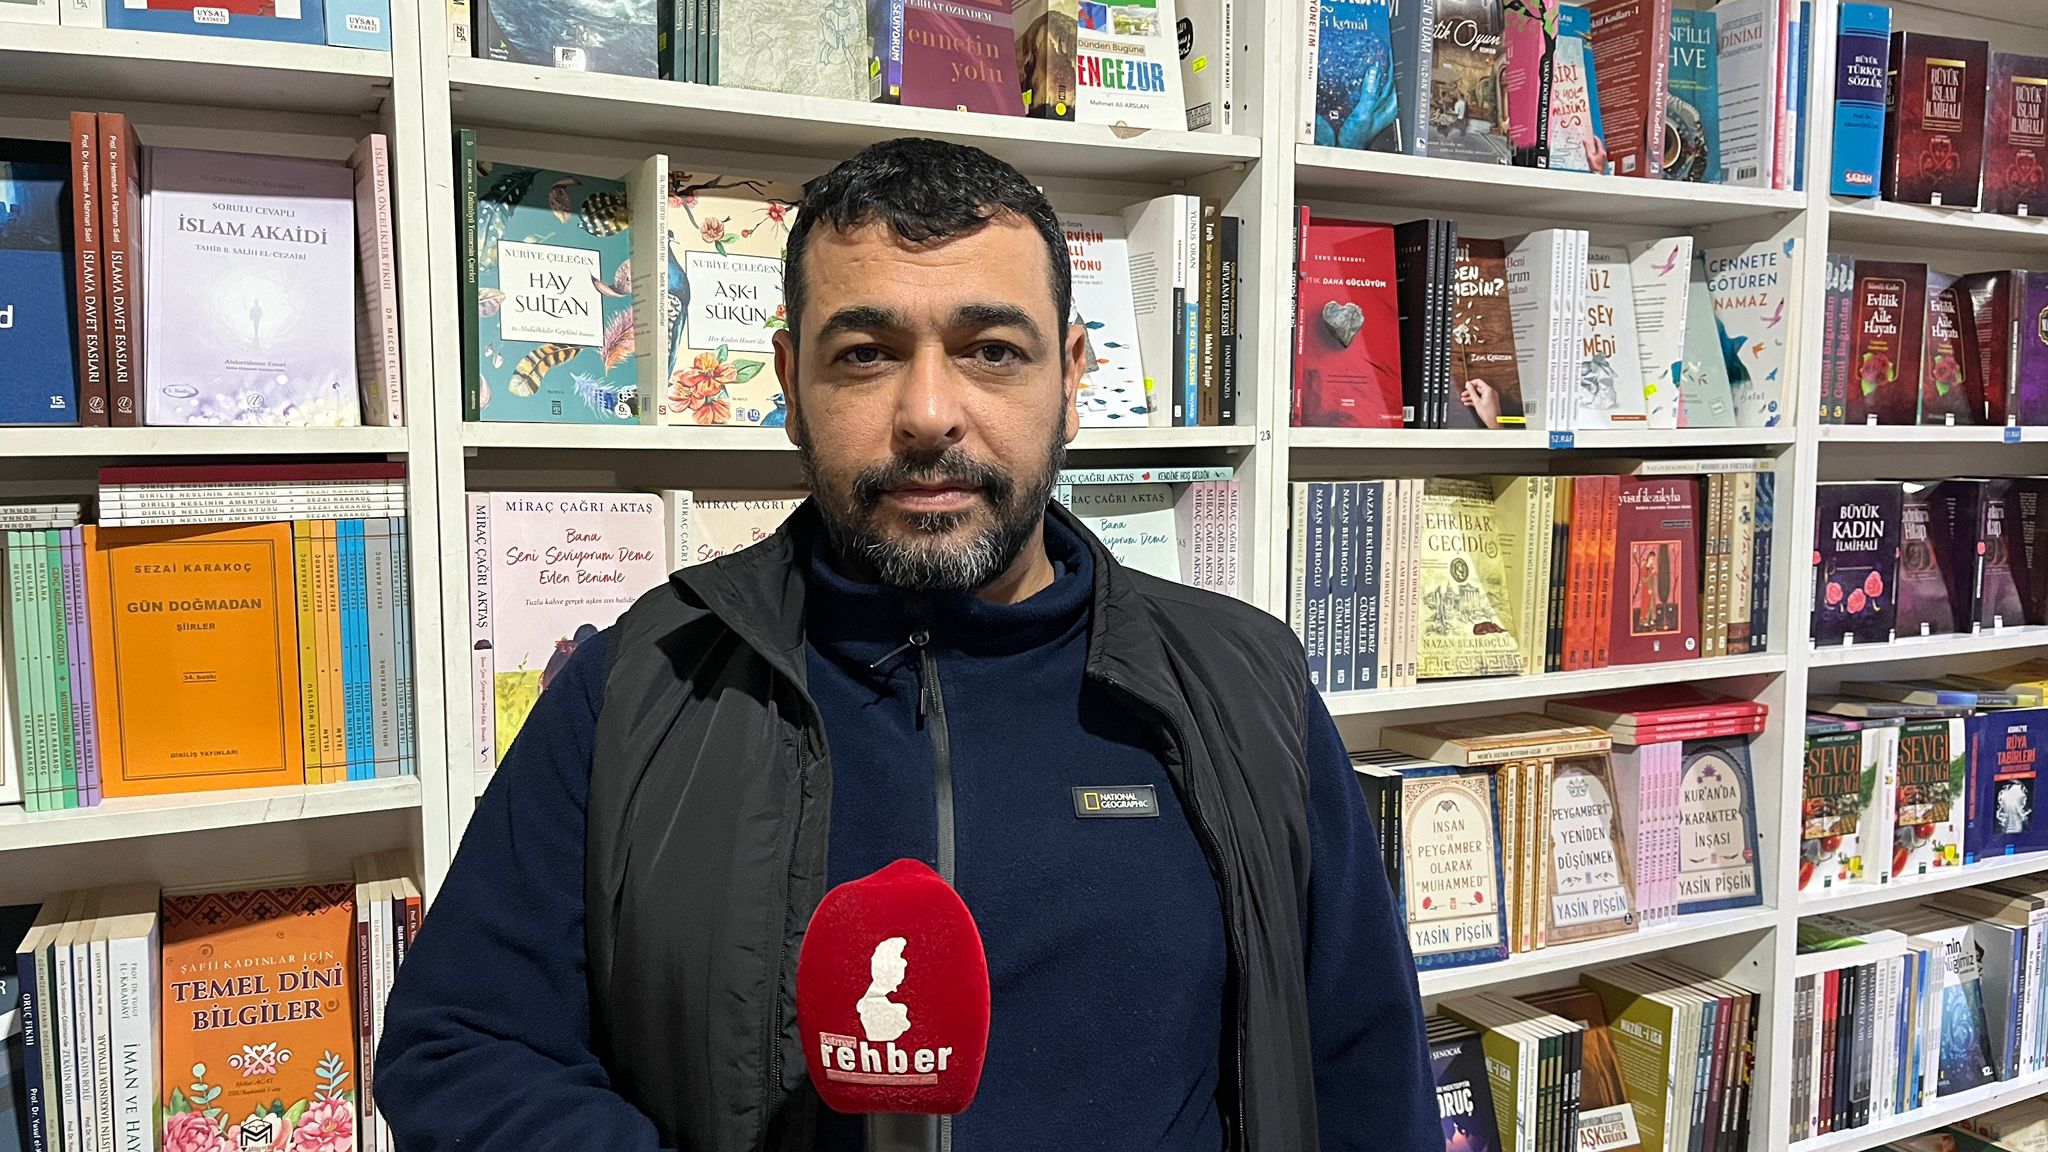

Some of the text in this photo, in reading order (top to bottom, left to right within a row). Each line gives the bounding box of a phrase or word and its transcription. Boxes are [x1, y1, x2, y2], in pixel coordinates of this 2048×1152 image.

[197, 9, 225, 19] UYSAL
[349, 17, 376, 27] UYSAL
[1454, 19, 1501, 52] Oyun
[1078, 39, 1145, 54] Dünden Bugüne
[1856, 56, 1878, 66] BÜYÜK
[951, 60, 1003, 83] yolu
[1076, 55, 1165, 92] ENGEZUR
[1847, 65, 1883, 78] TÜRKÇE
[1932, 68, 1959, 87] BÜYÜK
[1848, 76, 1883, 88] SÖZLÜK
[1932, 86, 1957, 103] İSLAM
[1925, 101, 1961, 120] İLMİHALİ
[2017, 102, 2040, 119] İSLAM
[2011, 117, 2043, 135] İLMİHALİ
[1845, 173, 1872, 184] SABAH
[212, 202, 295, 218] SORULU CEVAPLI
[178, 213, 328, 245] İSLAM AKAİDİ
[1189, 211, 1197, 269] YUNUS ORAN
[505, 248, 594, 266] NURİYE ÇELEĞEN
[1507, 256, 1526, 268] Beni
[1709, 252, 1778, 273] CENNETE
[693, 259, 776, 274] NURİYE ÇELEĞEN
[530, 271, 573, 295] HAY
[1222, 261, 1231, 299] MEVLANA
[1707, 272, 1778, 292] GÖTÜREN
[715, 281, 757, 301] AŞK-I
[515, 294, 589, 319] SULTAN
[1714, 293, 1768, 311] NAMAZ
[1866, 294, 1899, 308] Evlilik
[1931, 300, 1955, 314] Evlilik
[84, 297, 97, 332] DAVET
[113, 297, 126, 331] DAVET
[705, 302, 767, 326] SÜKÛN
[1221, 300, 1230, 336] FELSEFESİ
[1588, 304, 1613, 331] ŞEY
[1871, 310, 1892, 324] Aile
[1937, 316, 1953, 329] Aile
[1864, 321, 1897, 337] Hayatı
[1932, 326, 1958, 340] Hayatı
[87, 333, 99, 383] ESASLARI
[115, 333, 129, 382] ESASLARI
[1259, 431, 1272, 441] 28
[1551, 434, 1574, 444] 52.RAF
[1058, 470, 1210, 484] RAÇ ÇAĞRI AKTAŞ KENDİNE HOŞ GELDİN
[506, 499, 653, 515] MİRAÇ ÇAĞRI AKTAŞ
[695, 499, 784, 511] MİRAÇ ÇAĞRI
[1072, 493, 1165, 505] RAÇ ÇAĞRI AKTAŞ
[1840, 503, 1879, 519] BÜYÜK
[680, 498, 689, 562] MİRAÇ ÇAĞRI
[1101, 519, 1126, 531] Bana
[1425, 512, 1492, 532] EHRİBAR
[1832, 520, 1885, 540] KADIN
[566, 528, 602, 543] Bana
[1140, 532, 1168, 546] Deme
[1428, 533, 1484, 555] GEÇİDİ
[1836, 537, 1878, 552] İLMİHALİ
[506, 546, 654, 568] Seni Seviyorum Deme
[1313, 526, 1322, 587] BEKİROĞLU
[1340, 526, 1349, 586] BEKİROĞLU
[134, 561, 252, 575] SEZAİ KARAKOÇ
[474, 505, 489, 628] MİRAÇ ÇAĞRI AKTAŞ
[539, 569, 626, 584] Evlen Benimle
[127, 597, 262, 613] GÜN DOĞMADAN
[177, 621, 216, 633] ŞİİRLER
[1308, 599, 1317, 657] CÜMLELER
[1334, 598, 1343, 656] CÜMLELER
[1317, 625, 1325, 657] YERSİZ
[1424, 634, 1510, 649] NAZAN BEKİROĞLU
[1900, 734, 1949, 764] SEVGİ
[2006, 734, 2027, 749] RÜYA
[170, 748, 239, 759] DİRİLİŞ YAYINLARI
[1807, 744, 1862, 777] SEVGİ
[1997, 748, 2036, 765] TABİRLERİ
[1901, 762, 1949, 786] MUTFAĞI
[1684, 785, 1737, 802] KUR'AN'DA
[1807, 773, 1860, 797] MUTFAĞI
[1100, 793, 1137, 801] NATIONAL
[1101, 800, 1149, 809] GEOGRAPHIC
[1432, 818, 1465, 834] İNSAN
[1685, 809, 1738, 826] KARAKTER
[1561, 826, 1605, 844] YENİDEN
[1695, 832, 1731, 848] İNŞASI
[1418, 840, 1482, 857] PEYGAMBER
[1430, 859, 1473, 874] OLARAK
[1558, 850, 1614, 870] DÜŞÜNMEK
[1679, 871, 1751, 896] YASİN PİŞGİN
[1557, 894, 1626, 920] YASİN PİŞGİN
[1415, 922, 1493, 947] YASİN PİŞGİN
[180, 950, 334, 975] ŞAFİİ KADINLAR İÇİN
[170, 961, 345, 1002] TEMEL DİNİ
[23, 993, 32, 1020] ORUÇ
[192, 998, 324, 1032] BİLGİLER
[26, 1020, 35, 1046] FIKHI
[821, 1034, 856, 1047] Batman
[123, 1043, 139, 1090] İMAN
[821, 1042, 952, 1073] rehber
[98, 1034, 109, 1122] HAKKINDA FETVALAR
[30, 1088, 38, 1105] Prof.
[125, 1096, 138, 1113] VE
[1579, 1127, 1605, 1151] AŞK
